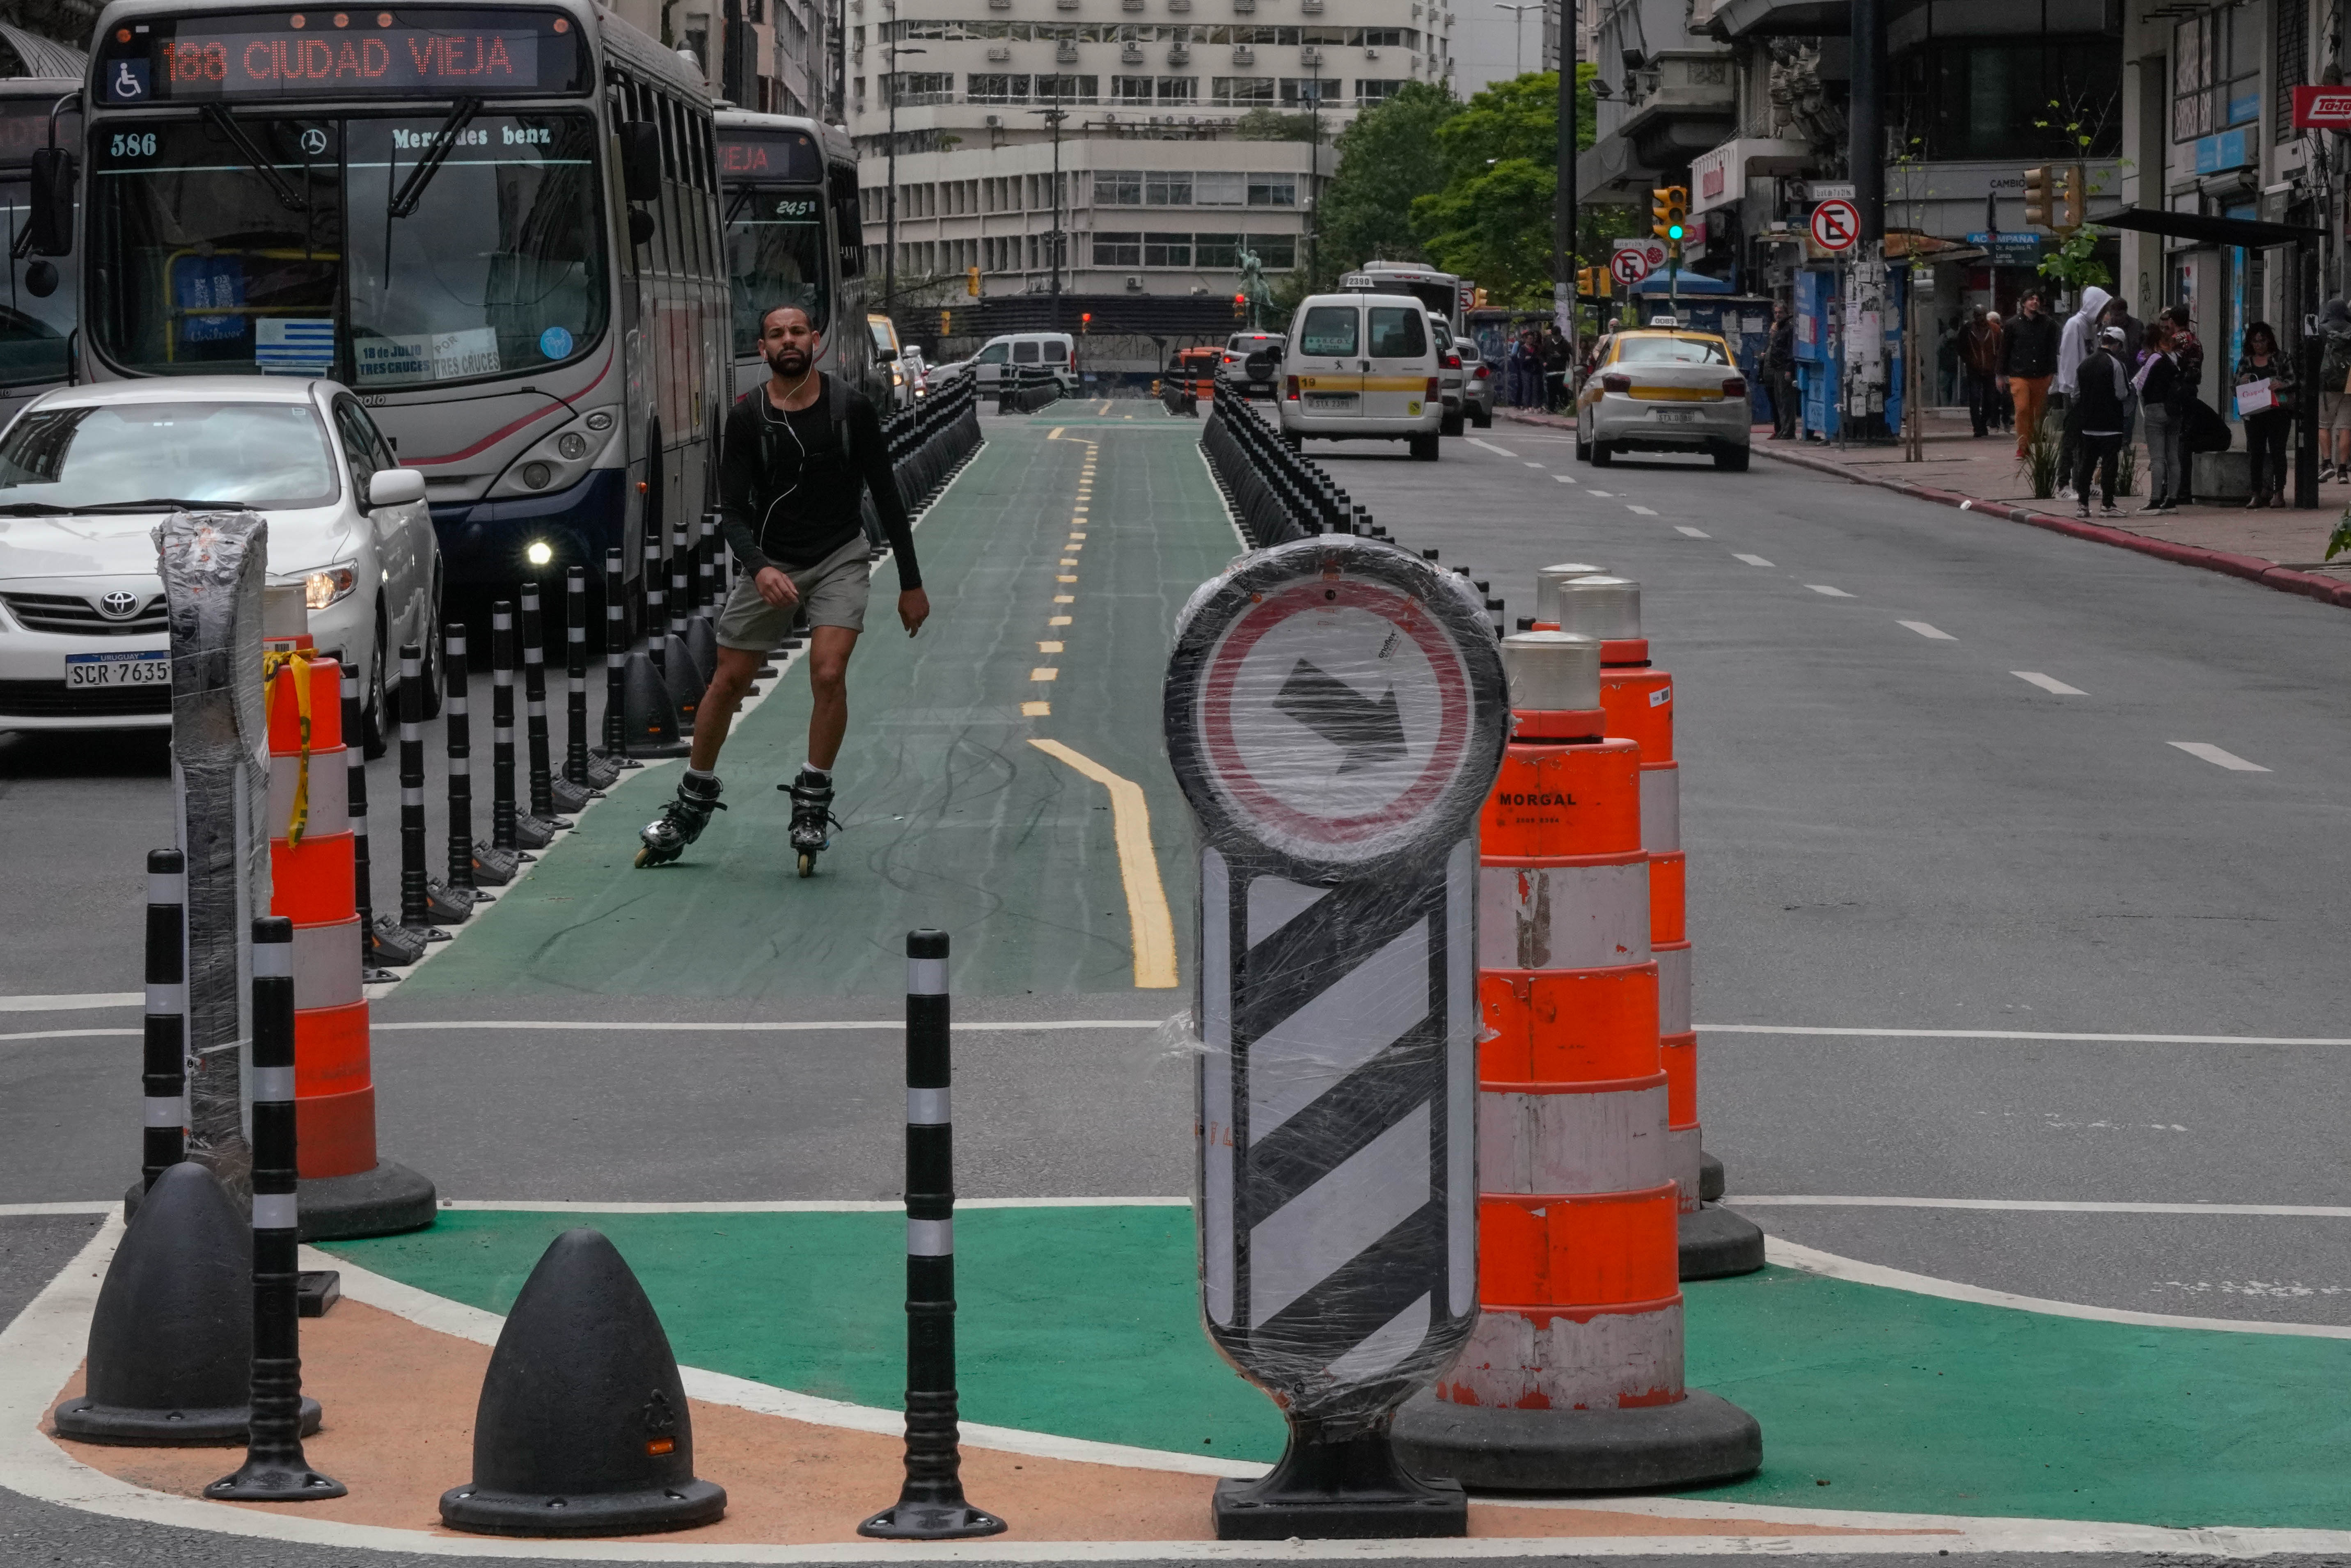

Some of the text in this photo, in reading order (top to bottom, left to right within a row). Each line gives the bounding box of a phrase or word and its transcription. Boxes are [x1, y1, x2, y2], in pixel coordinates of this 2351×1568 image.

[163, 36, 513, 81] 188 CIUDAD VIEJA
[502, 126, 550, 145] benz
[111, 133, 156, 156] 586
[1990, 179, 2025, 188] CAMBIO
[191, 327, 244, 341] Unilever
[363, 344, 422, 359] 18 de JULIO
[435, 335, 459, 354] POR
[359, 359, 430, 375] TRES CRUCES
[433, 351, 500, 378] TRES CRUCES
[1301, 378, 1316, 387] 19
[73, 662, 167, 684] SCR 7635
[1500, 794, 1576, 805] MORGAL
